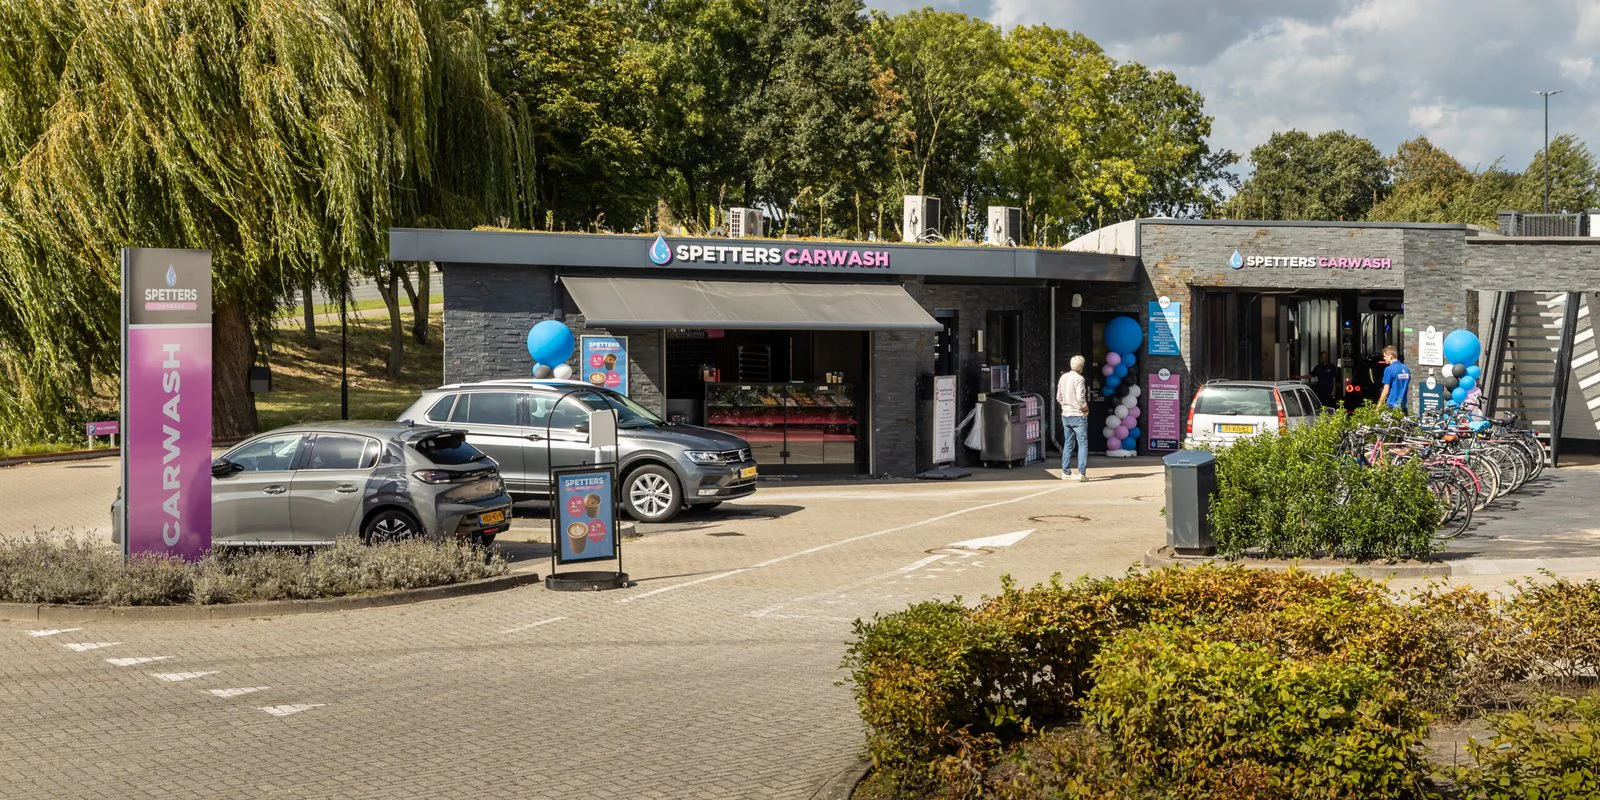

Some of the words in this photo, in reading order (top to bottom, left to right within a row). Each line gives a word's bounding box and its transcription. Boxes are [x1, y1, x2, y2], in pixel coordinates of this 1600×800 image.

[676, 244, 781, 263] SPETTERS
[784, 248, 890, 268] CARWASH
[1246, 255, 1317, 268] SPETTERS
[1318, 257, 1392, 269] CARWASH
[145, 288, 198, 301] SPETTERS
[162, 343, 181, 547] CARWASH
[564, 477, 605, 487] SPETTERS
